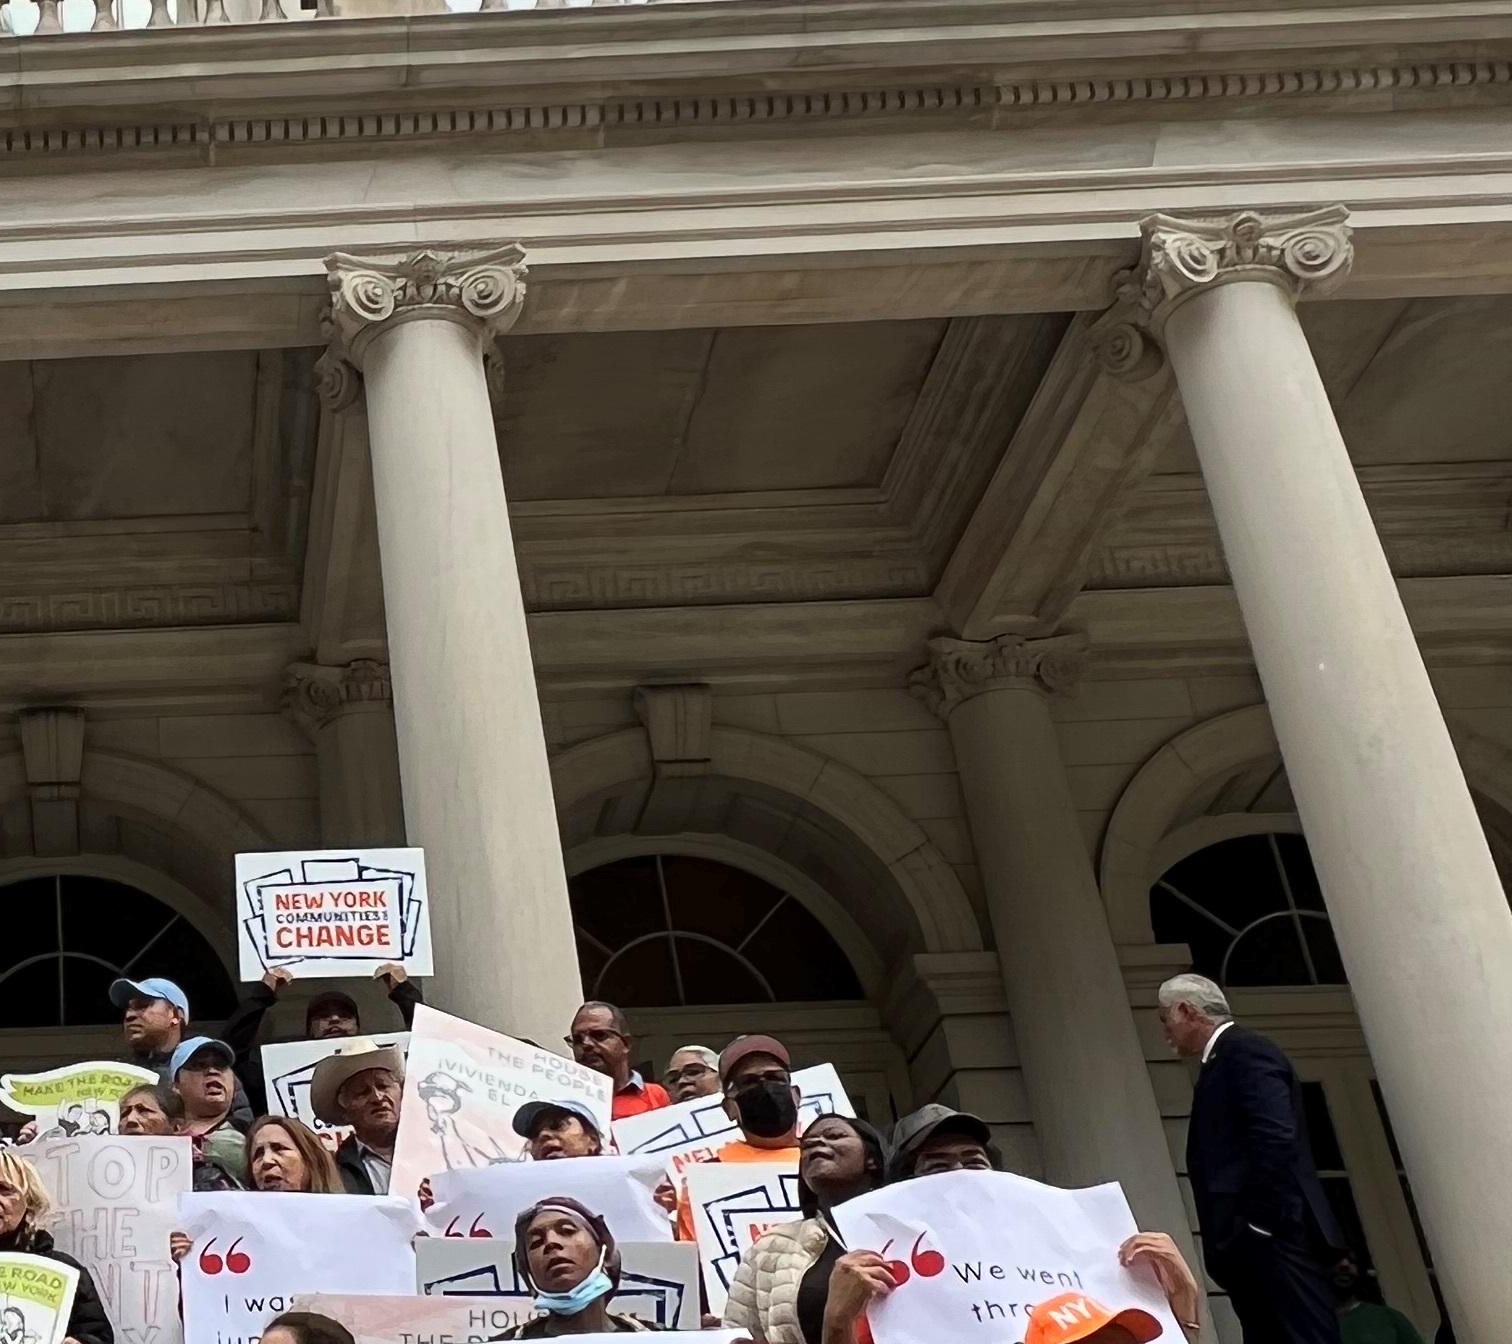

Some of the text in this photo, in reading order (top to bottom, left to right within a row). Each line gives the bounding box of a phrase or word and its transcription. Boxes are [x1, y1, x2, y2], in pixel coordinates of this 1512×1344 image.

[275, 890, 387, 910] NEW YORK
[276, 924, 391, 949] CHANGE
[487, 1047, 608, 1103] THE PEOPLE
[45, 1142, 179, 1207] TOP
[11, 1267, 62, 1290] ROAD
[952, 1261, 1084, 1289] We went
